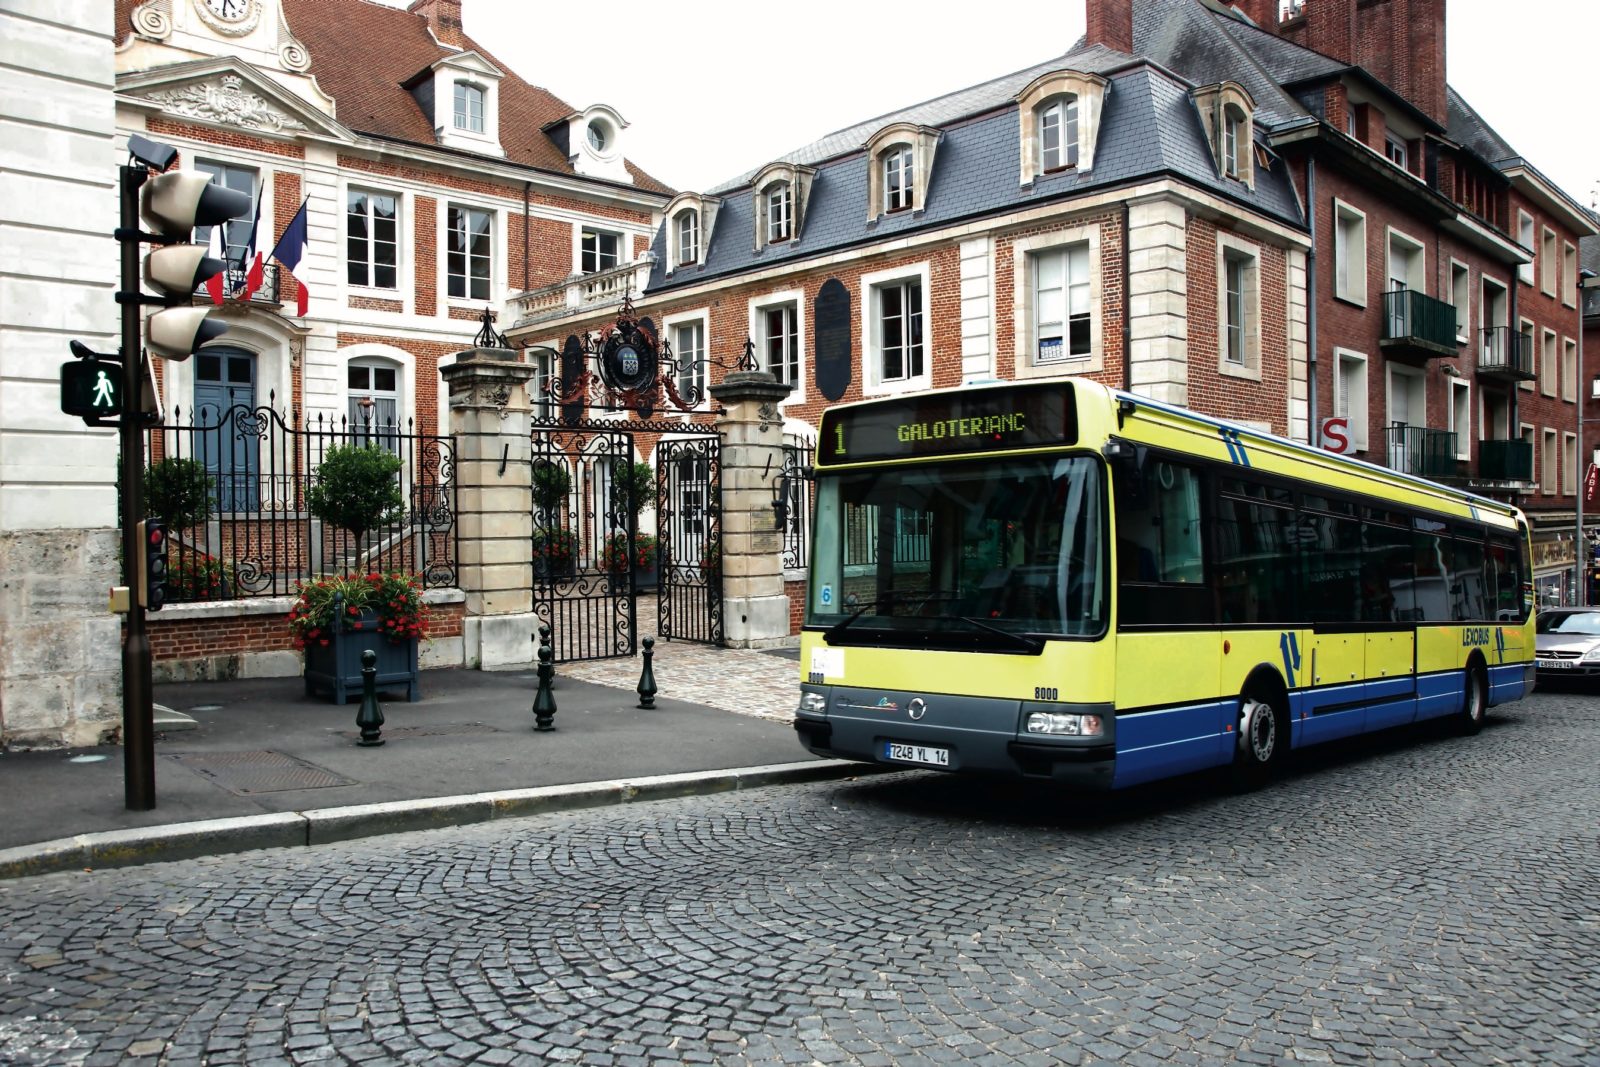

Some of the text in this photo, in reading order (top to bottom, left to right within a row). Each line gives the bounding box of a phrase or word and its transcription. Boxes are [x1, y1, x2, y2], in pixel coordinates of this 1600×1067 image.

[835, 423, 846, 454] 1
[1323, 418, 1348, 454] S
[1587, 464, 1597, 500] TABAC
[822, 588, 831, 603] 6
[1462, 627, 1489, 647] LEXOBUS
[1034, 686, 1058, 701] 8000
[891, 744, 947, 763] 7248 YL 14
